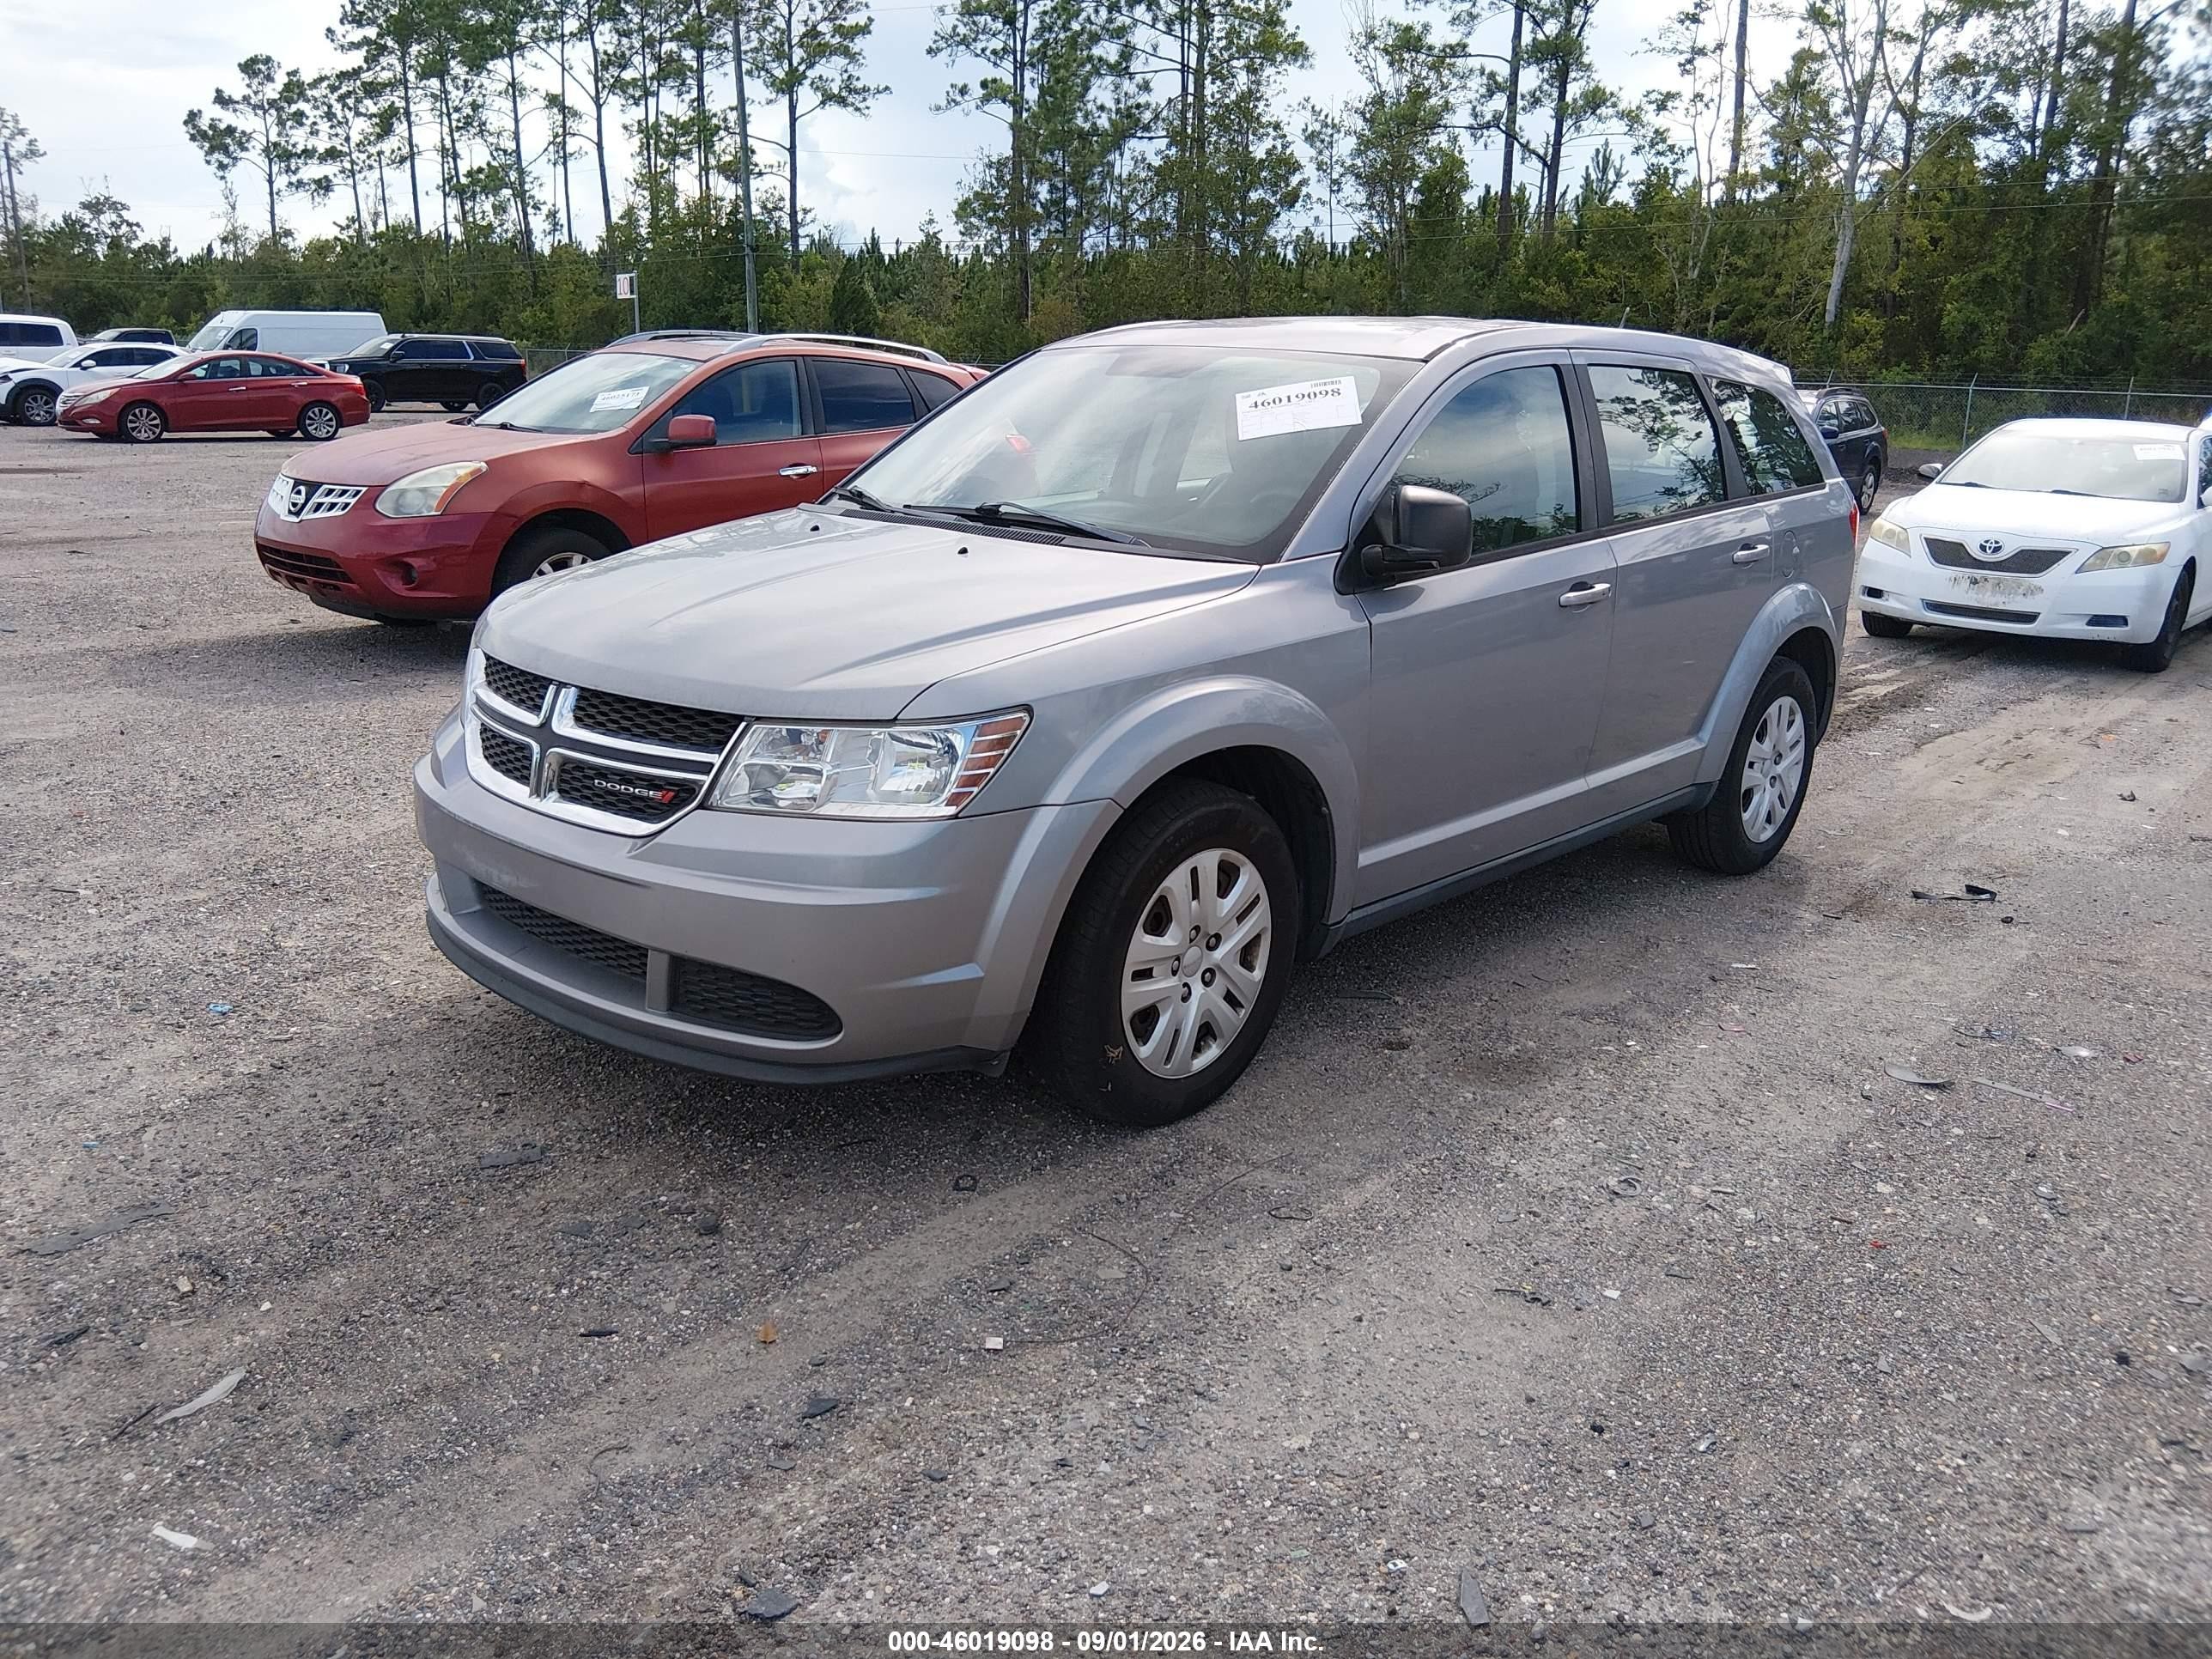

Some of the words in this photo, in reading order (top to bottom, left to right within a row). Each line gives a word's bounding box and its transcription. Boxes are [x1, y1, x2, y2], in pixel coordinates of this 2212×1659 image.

[618, 276, 629, 295] 10
[1249, 387, 1342, 410] 46019098
[594, 779, 663, 799] DODGE
